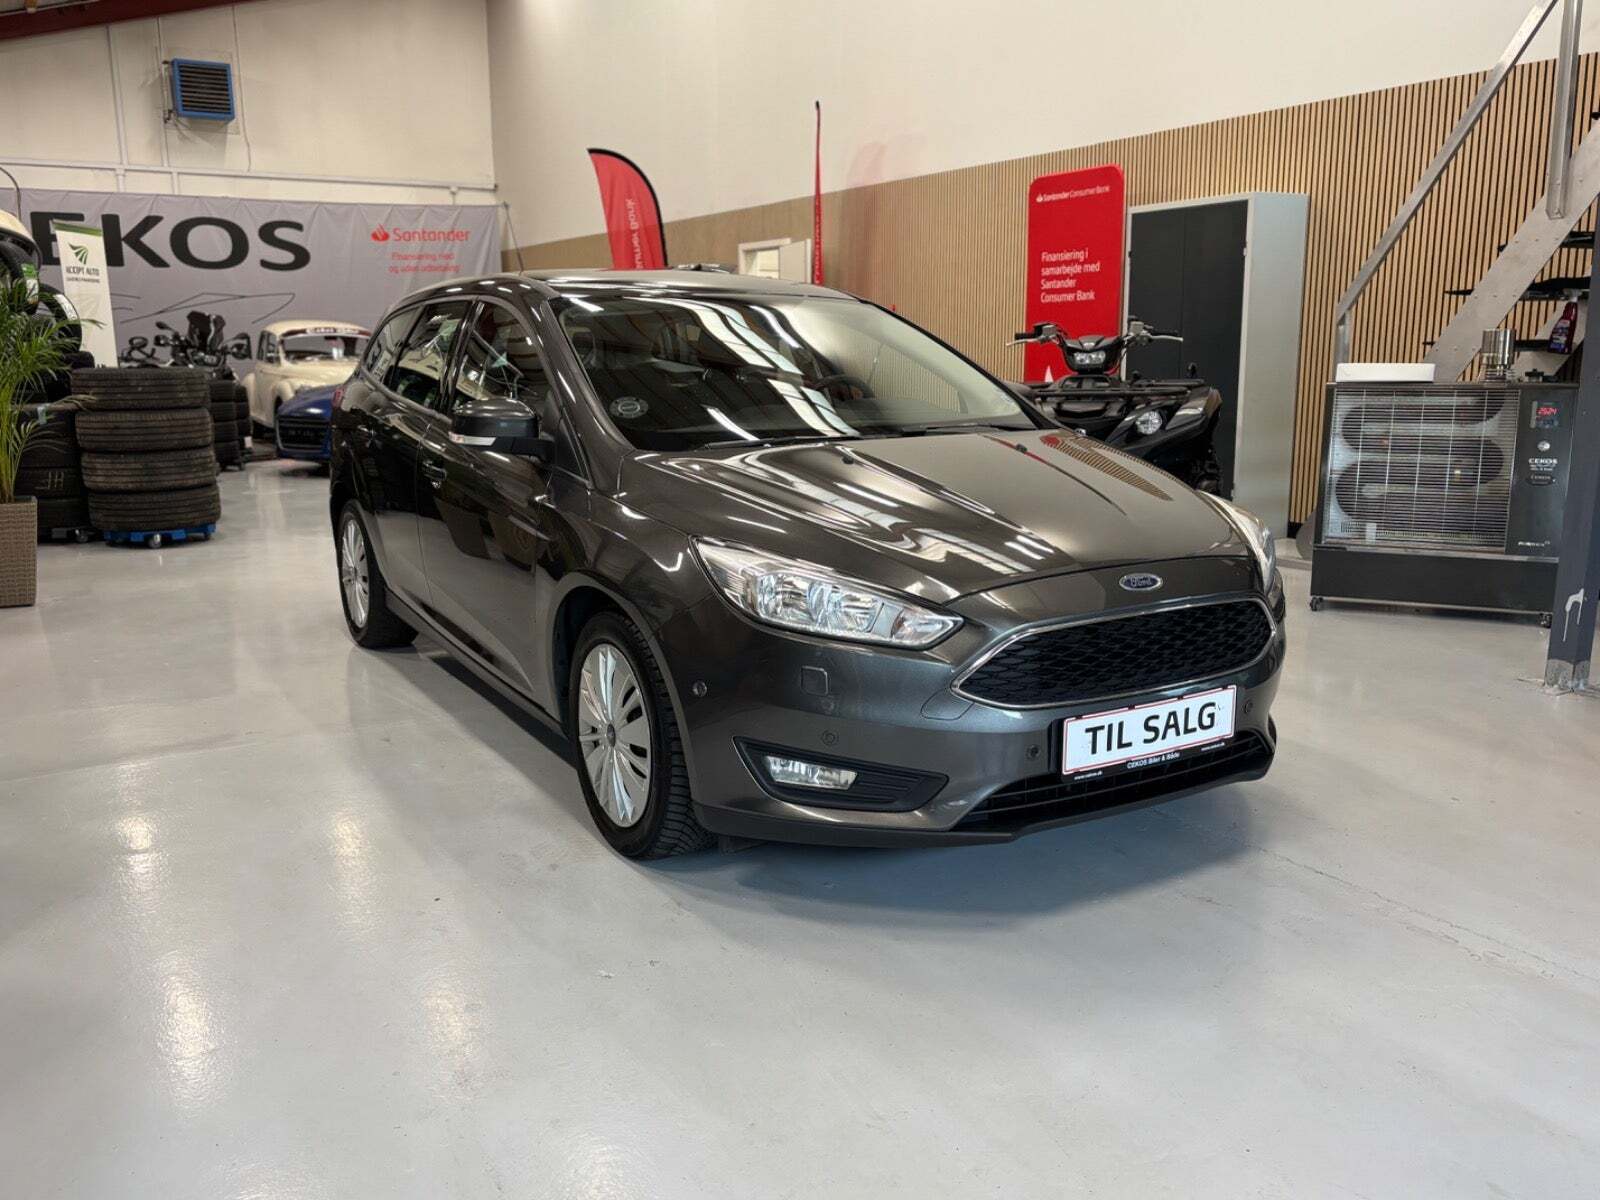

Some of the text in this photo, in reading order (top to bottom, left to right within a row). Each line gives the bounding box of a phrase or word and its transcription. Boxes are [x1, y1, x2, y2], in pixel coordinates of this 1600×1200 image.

[393, 226, 471, 242] Santander
[1041, 249, 1085, 262] Finansiering
[1041, 260, 1101, 276] samarbejde med
[1041, 277, 1077, 290] Santander
[1041, 288, 1096, 303] Consumer Bank
[1085, 702, 1217, 755] TIL SALG
